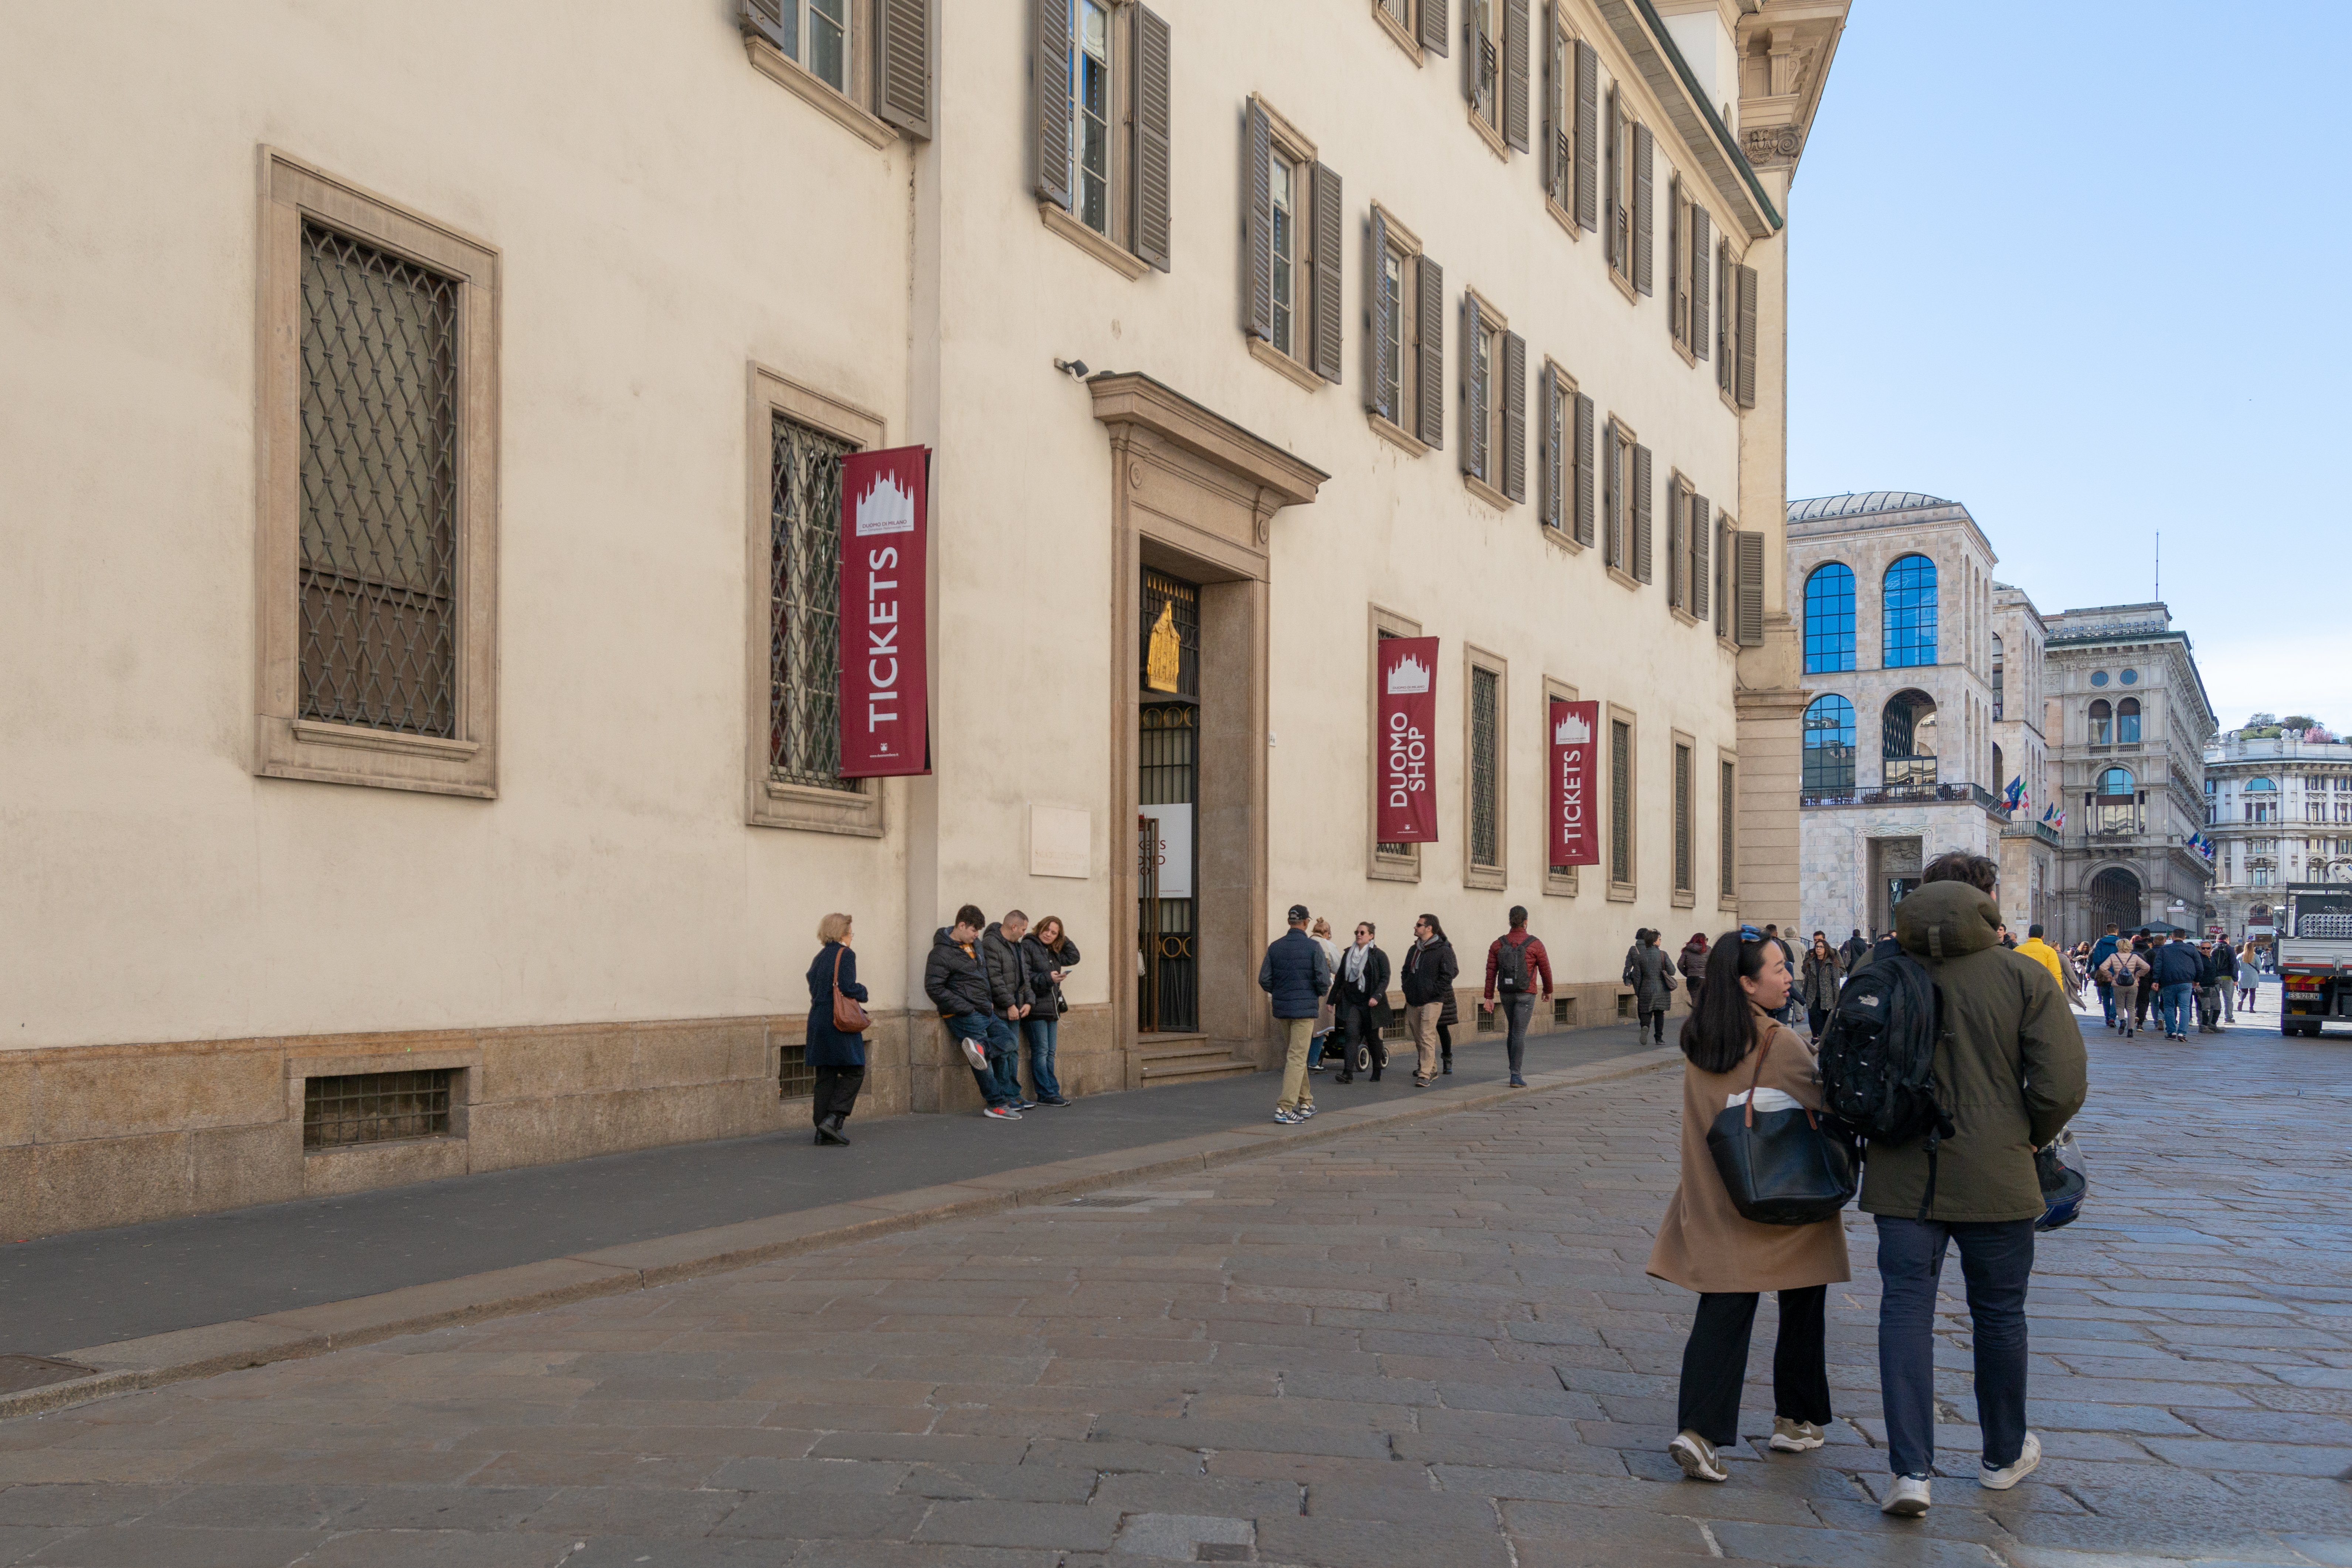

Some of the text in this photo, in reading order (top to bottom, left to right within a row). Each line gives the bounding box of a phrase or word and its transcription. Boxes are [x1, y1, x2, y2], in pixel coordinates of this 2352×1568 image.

[869, 547, 898, 732] TICKETS
[1390, 712, 1408, 807] DUOMO
[1408, 727, 1425, 791] SHOP
[1564, 750, 1581, 844] TICKETS
